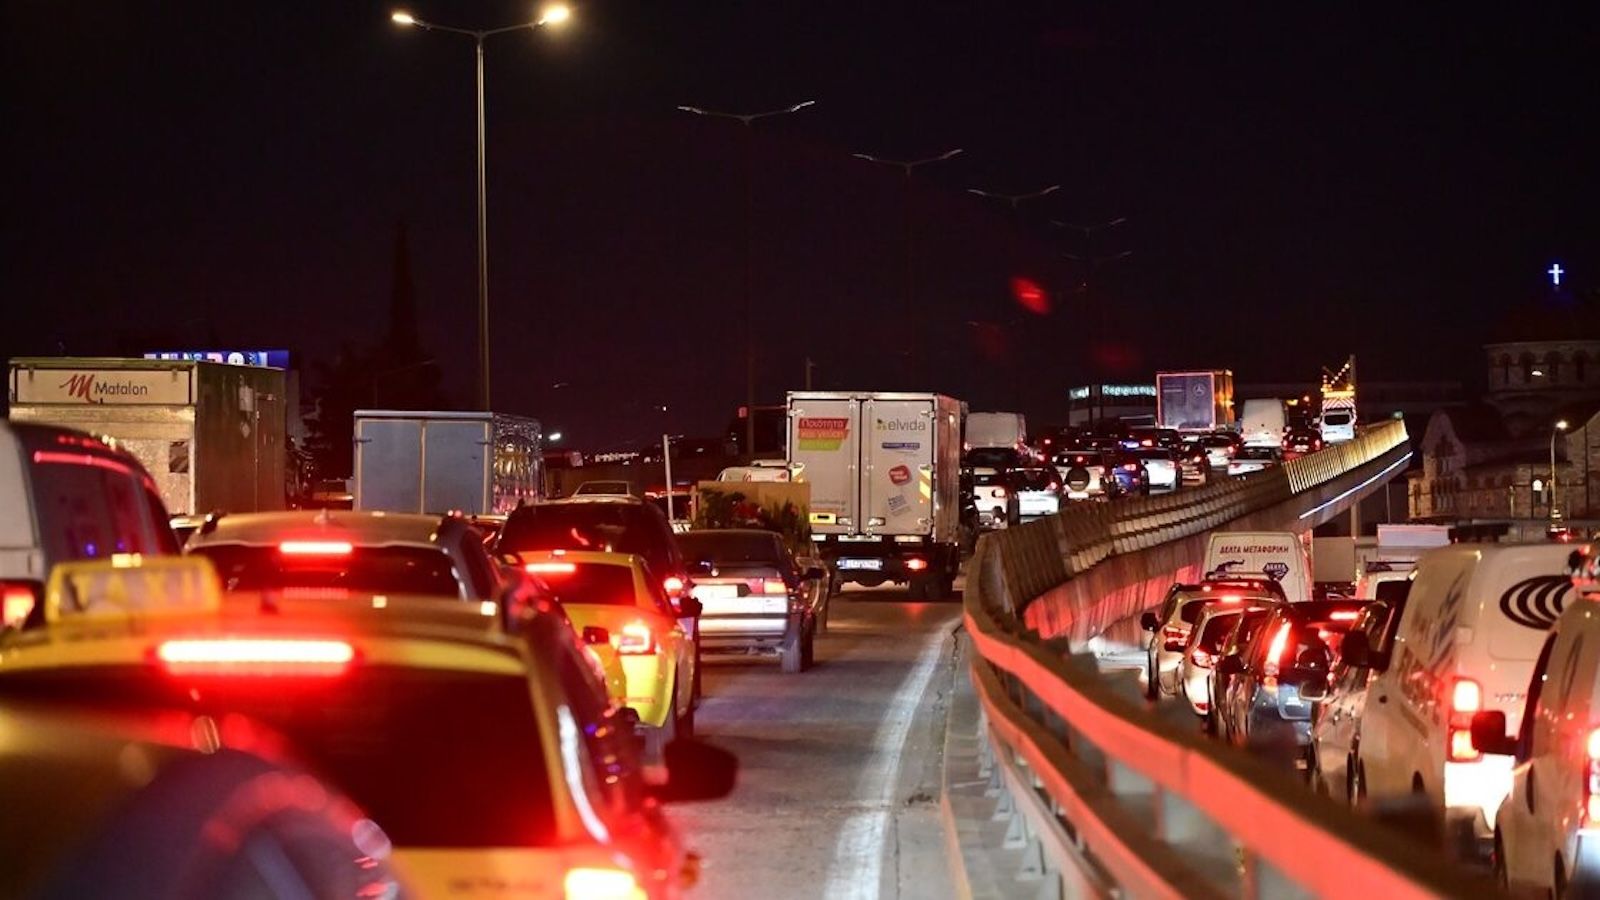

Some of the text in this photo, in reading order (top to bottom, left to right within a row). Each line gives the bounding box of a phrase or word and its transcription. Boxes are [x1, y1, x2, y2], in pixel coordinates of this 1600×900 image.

[95, 381, 148, 397] Matalon
[888, 418, 926, 431] elvida
[1220, 545, 1289, 554] ΔΕΛΤΑ ΜΕΤΑΦΟΡΙΚΗ
